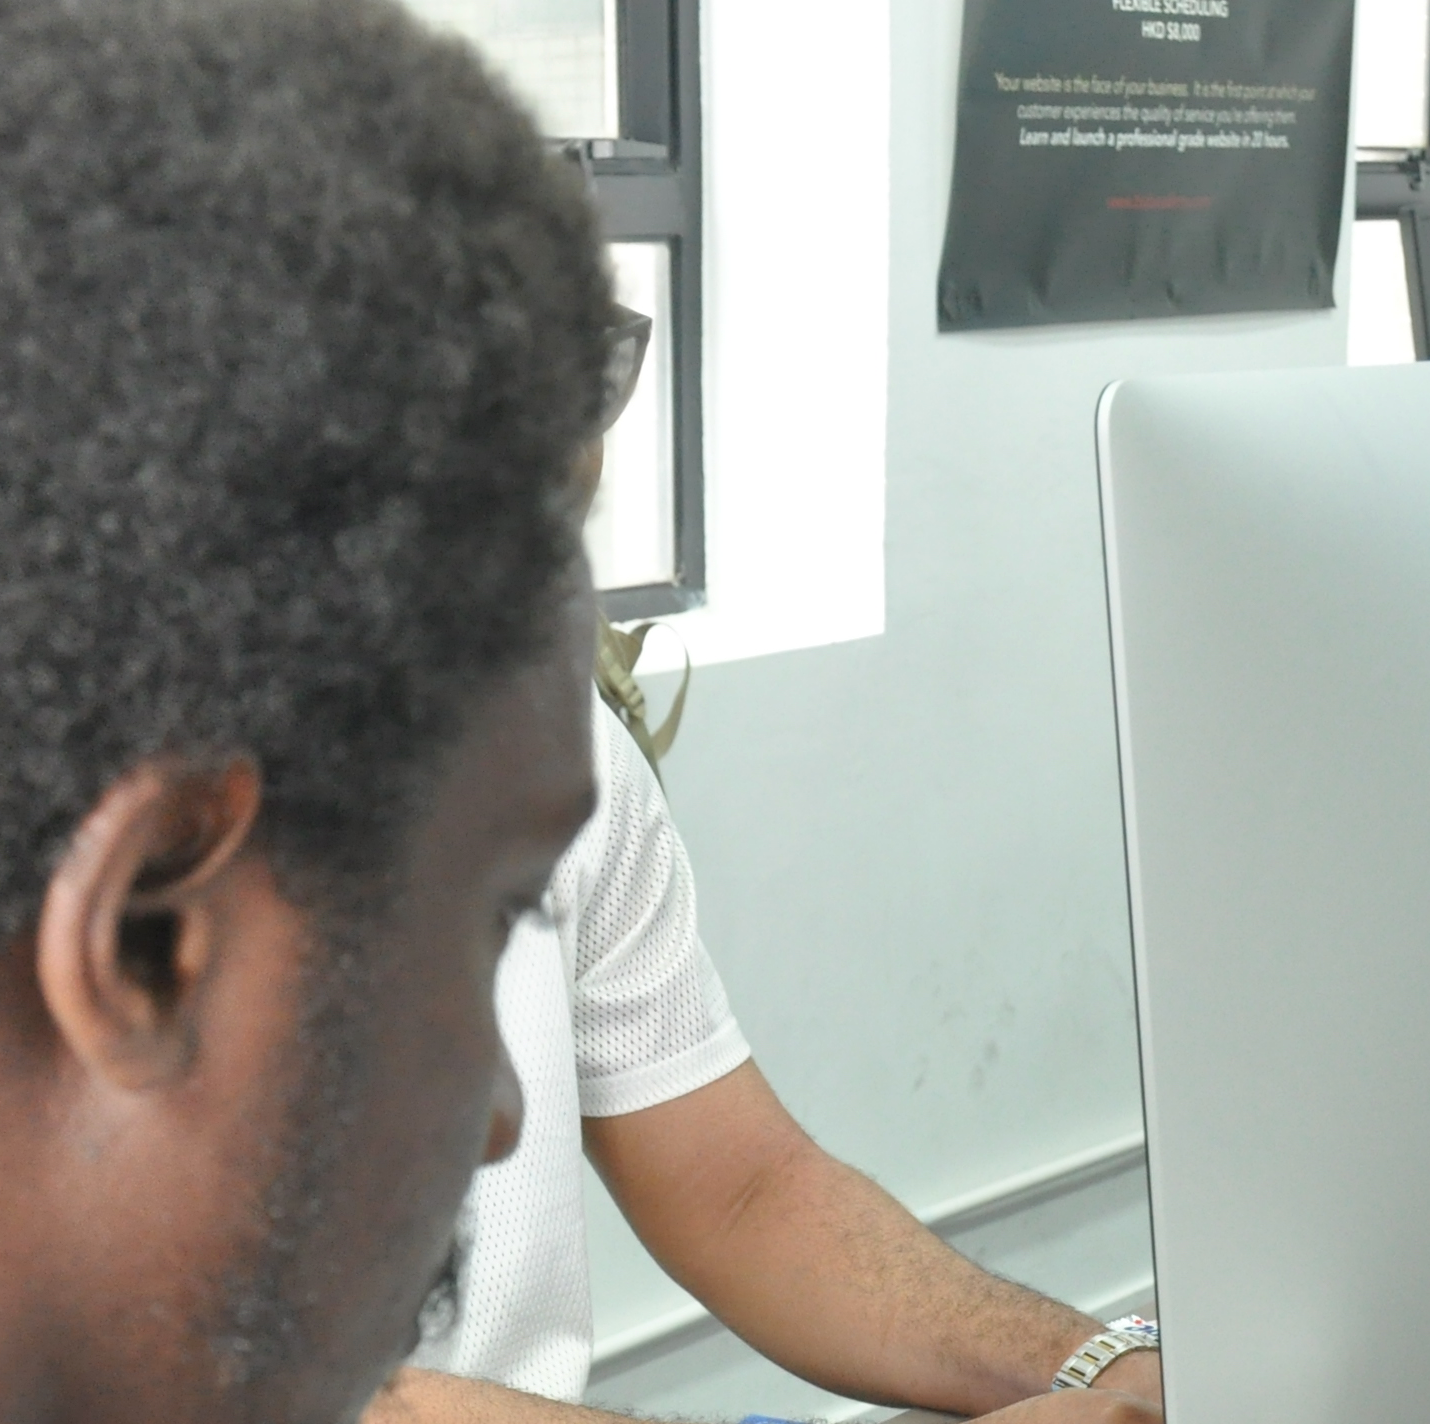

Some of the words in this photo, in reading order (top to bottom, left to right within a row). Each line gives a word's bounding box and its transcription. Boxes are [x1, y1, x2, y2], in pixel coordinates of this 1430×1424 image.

[1164, 0, 1229, 18] SCHEDULING
[1142, 20, 1165, 39] HKD
[1167, 22, 1201, 42] $8,000
[994, 72, 1021, 91] Your
[1022, 72, 1062, 93] website
[1073, 75, 1089, 93] the
[1092, 74, 1111, 94] face
[1113, 76, 1125, 94] of
[1125, 81, 1146, 99] your
[1017, 104, 1063, 120] customer
[1063, 104, 1121, 123] experiences
[1123, 102, 1139, 120] the
[1140, 104, 1172, 126] quality
[1019, 127, 1049, 146] Learn
[1050, 127, 1071, 146] and
[1072, 127, 1106, 146] launch
[1107, 132, 1115, 147] a
[1115, 128, 1177, 151] professional
[1178, 129, 1205, 152] grade
[1206, 130, 1240, 147] website
